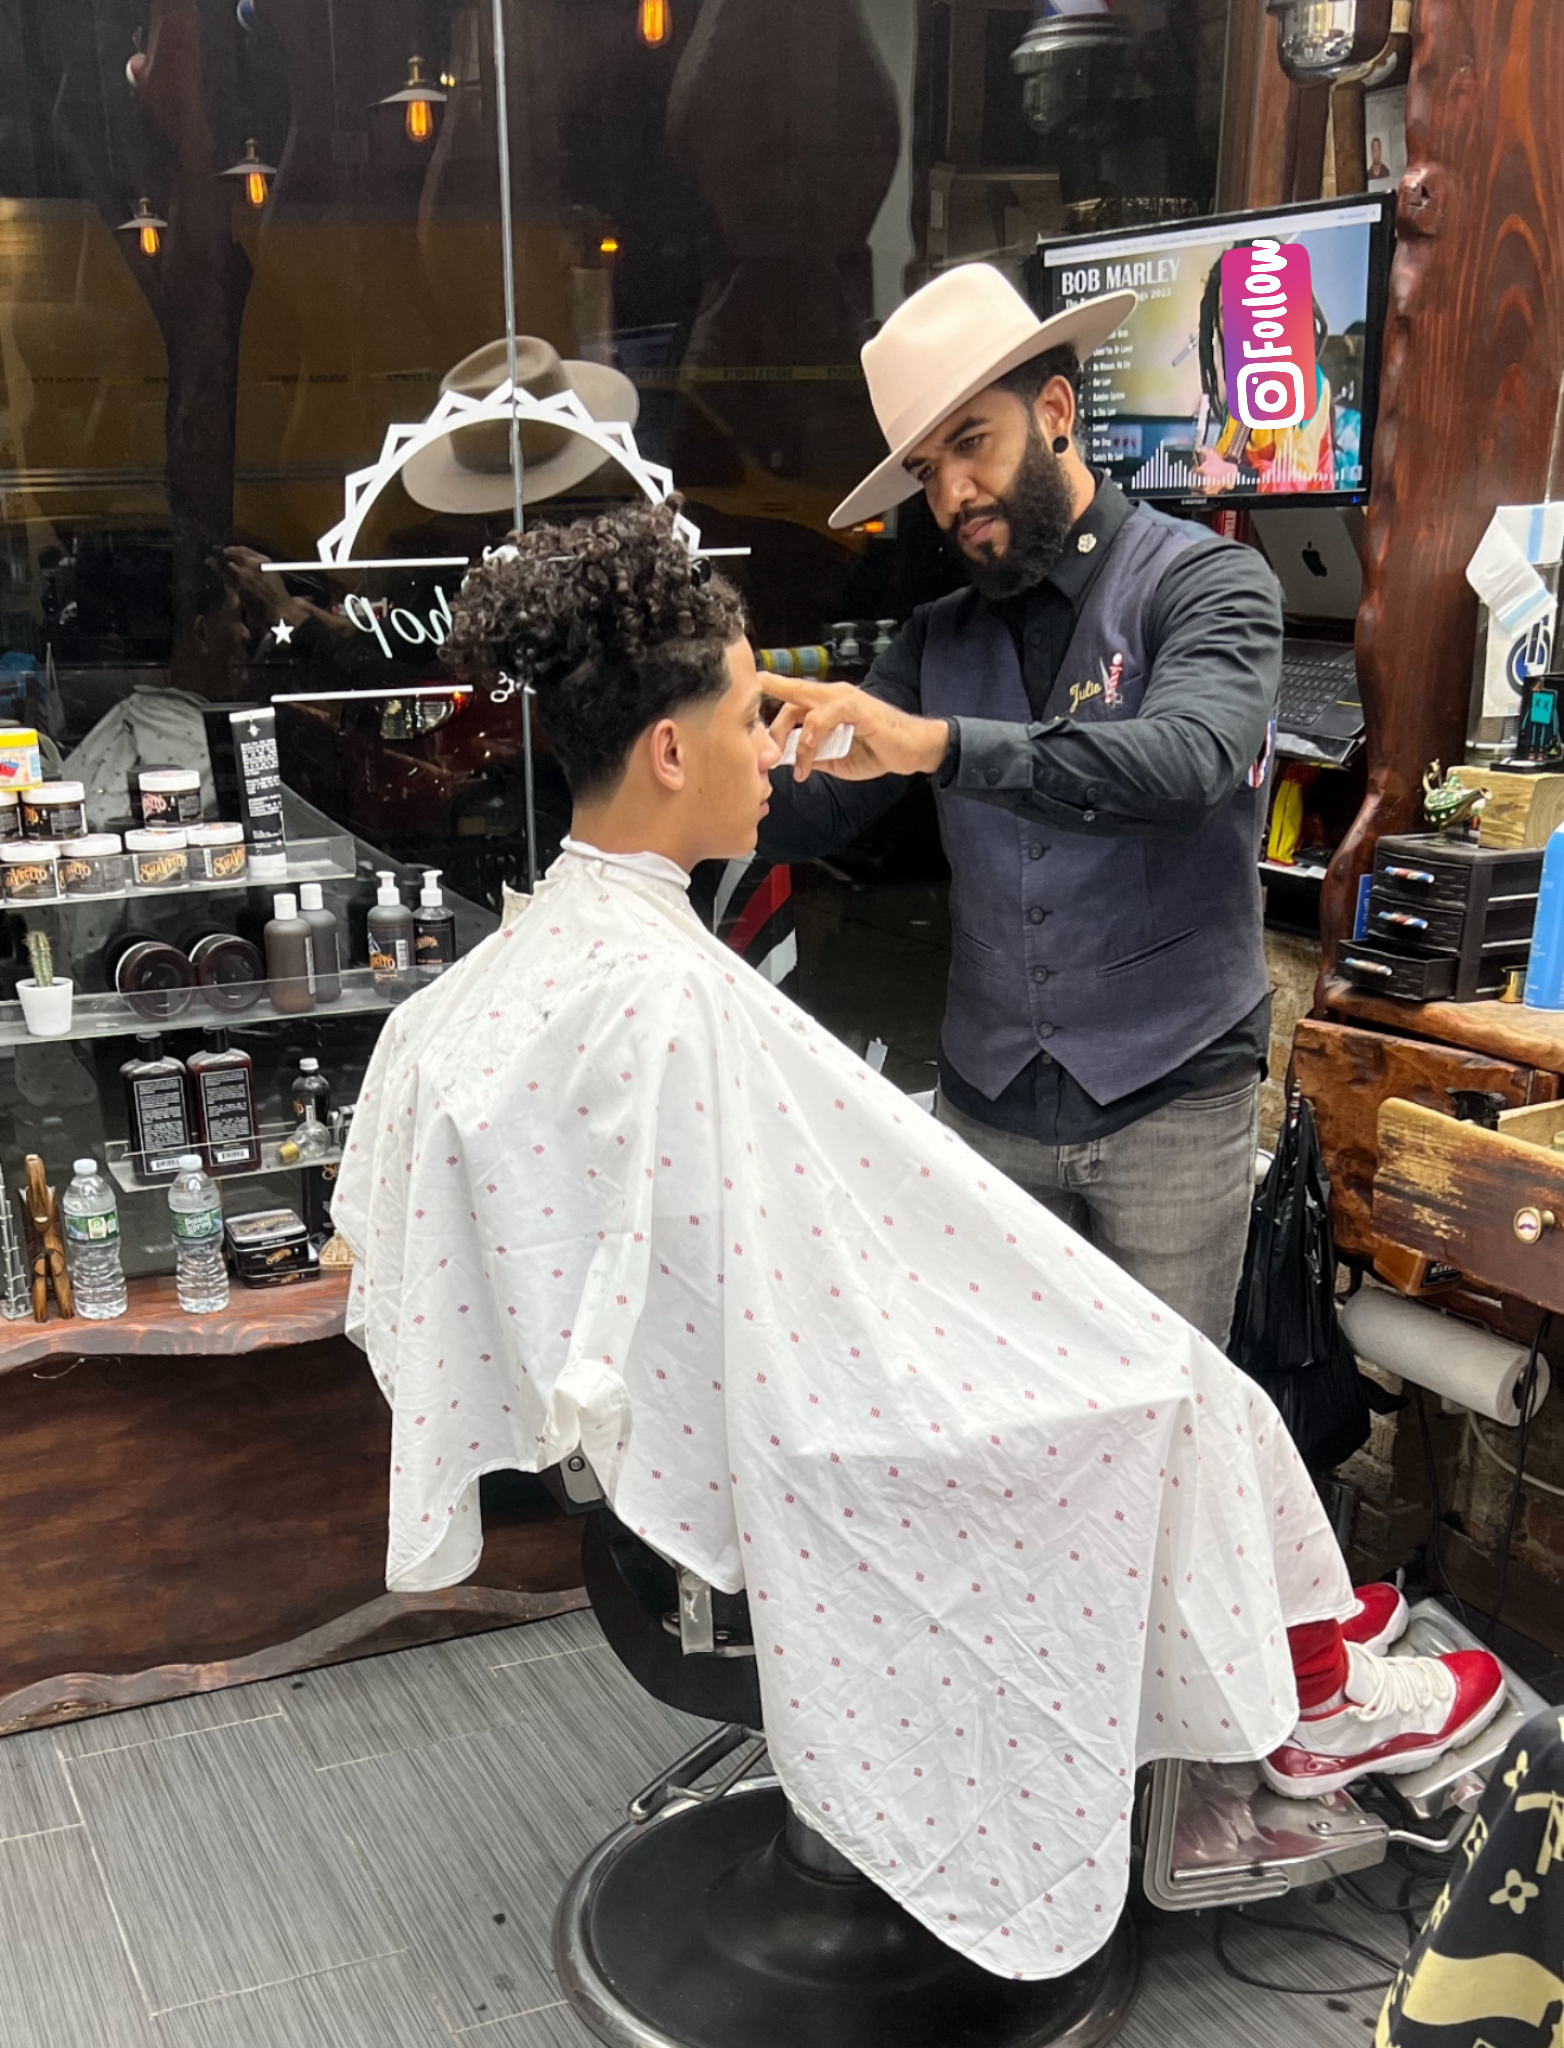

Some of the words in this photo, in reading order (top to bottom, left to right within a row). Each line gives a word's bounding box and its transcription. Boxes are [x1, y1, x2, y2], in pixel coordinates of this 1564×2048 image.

[1061, 268, 1100, 296] BOB
[1106, 258, 1180, 290] MARLEY
[1069, 679, 1102, 714] Julio
